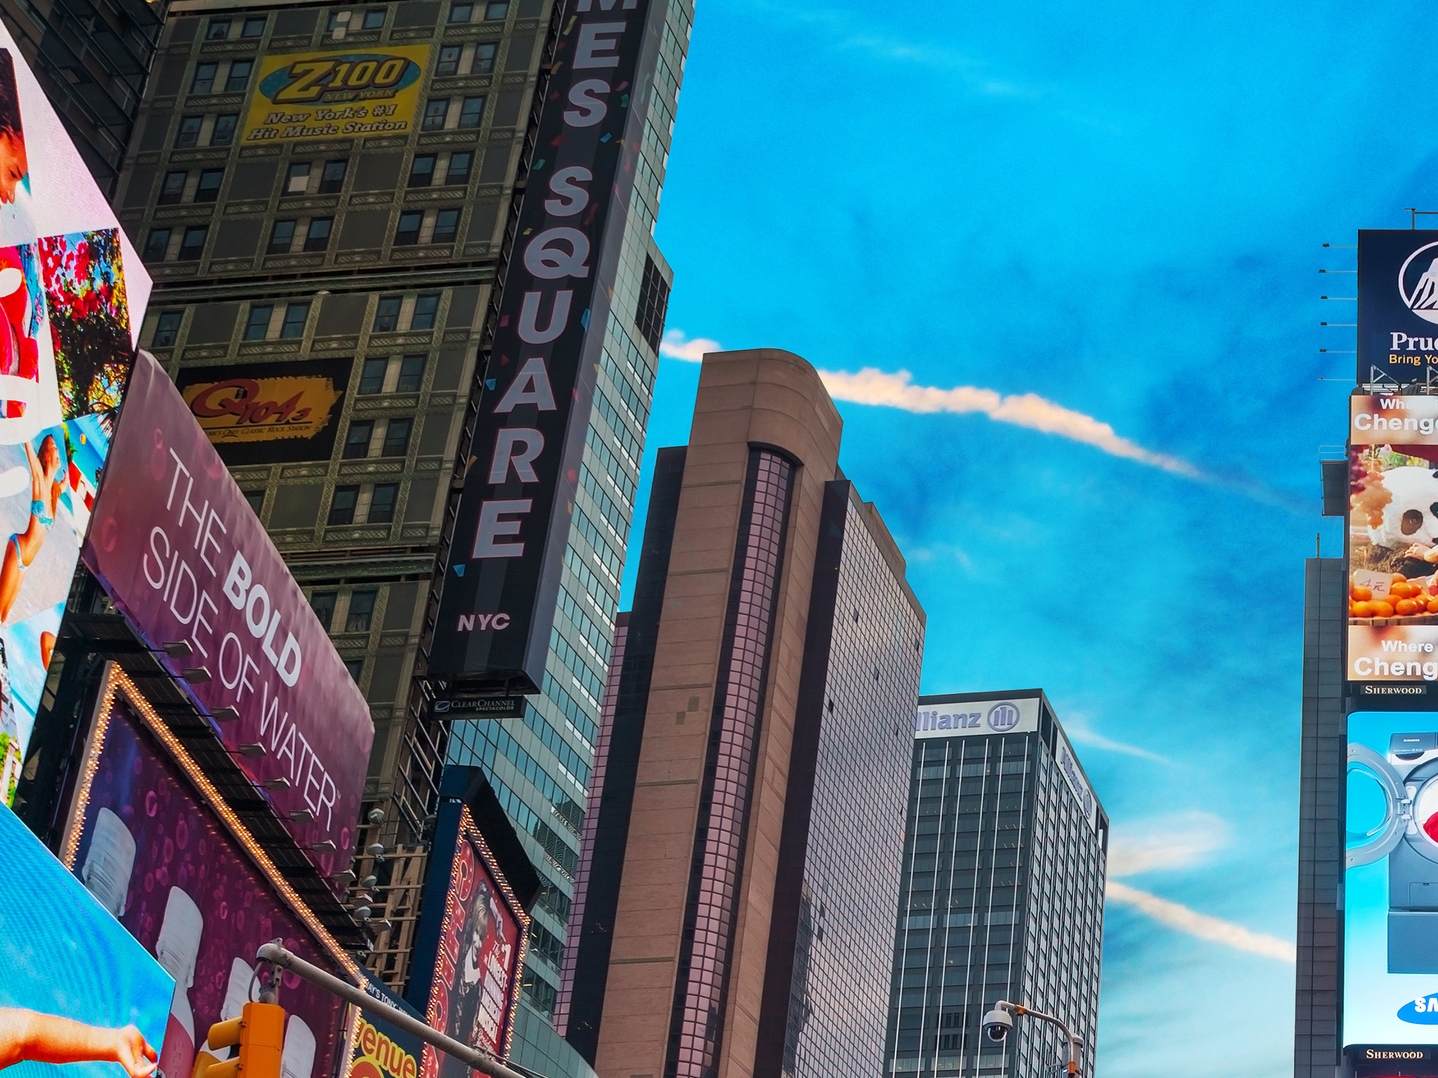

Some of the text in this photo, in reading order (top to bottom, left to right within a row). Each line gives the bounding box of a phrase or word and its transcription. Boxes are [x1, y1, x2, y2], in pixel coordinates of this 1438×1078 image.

[273, 57, 409, 103] Z100
[264, 104, 397, 124] New York's #1
[247, 120, 407, 140] Hit Music Station
[472, 166, 593, 558] SQUARE
[1389, 355, 1421, 366] Bring
[165, 448, 227, 576] THE
[223, 551, 302, 687] BOLD
[458, 613, 510, 631] NYC
[1381, 640, 1433, 653] Where
[144, 527, 336, 832] SIDE OF WATER
[1365, 685, 1422, 695] SHERWOOD
[1366, 1049, 1423, 1060] SHERWOOD
